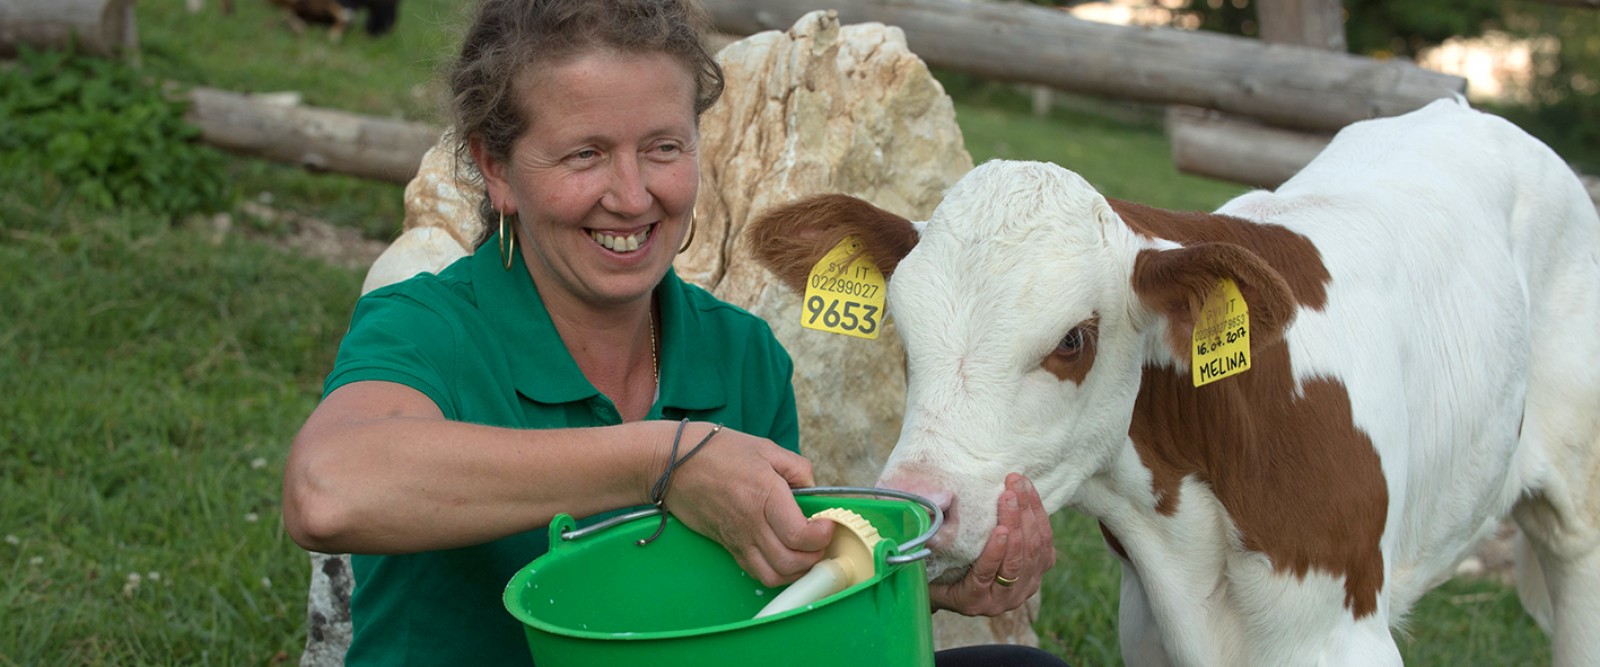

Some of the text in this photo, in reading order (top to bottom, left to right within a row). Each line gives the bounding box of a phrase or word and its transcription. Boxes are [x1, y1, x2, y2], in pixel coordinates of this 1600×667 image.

[855, 266, 870, 280] IT
[811, 274, 879, 299] 02299027
[807, 295, 878, 334] 9653
[1225, 298, 1236, 315] IT
[1199, 351, 1247, 382] MELINA
